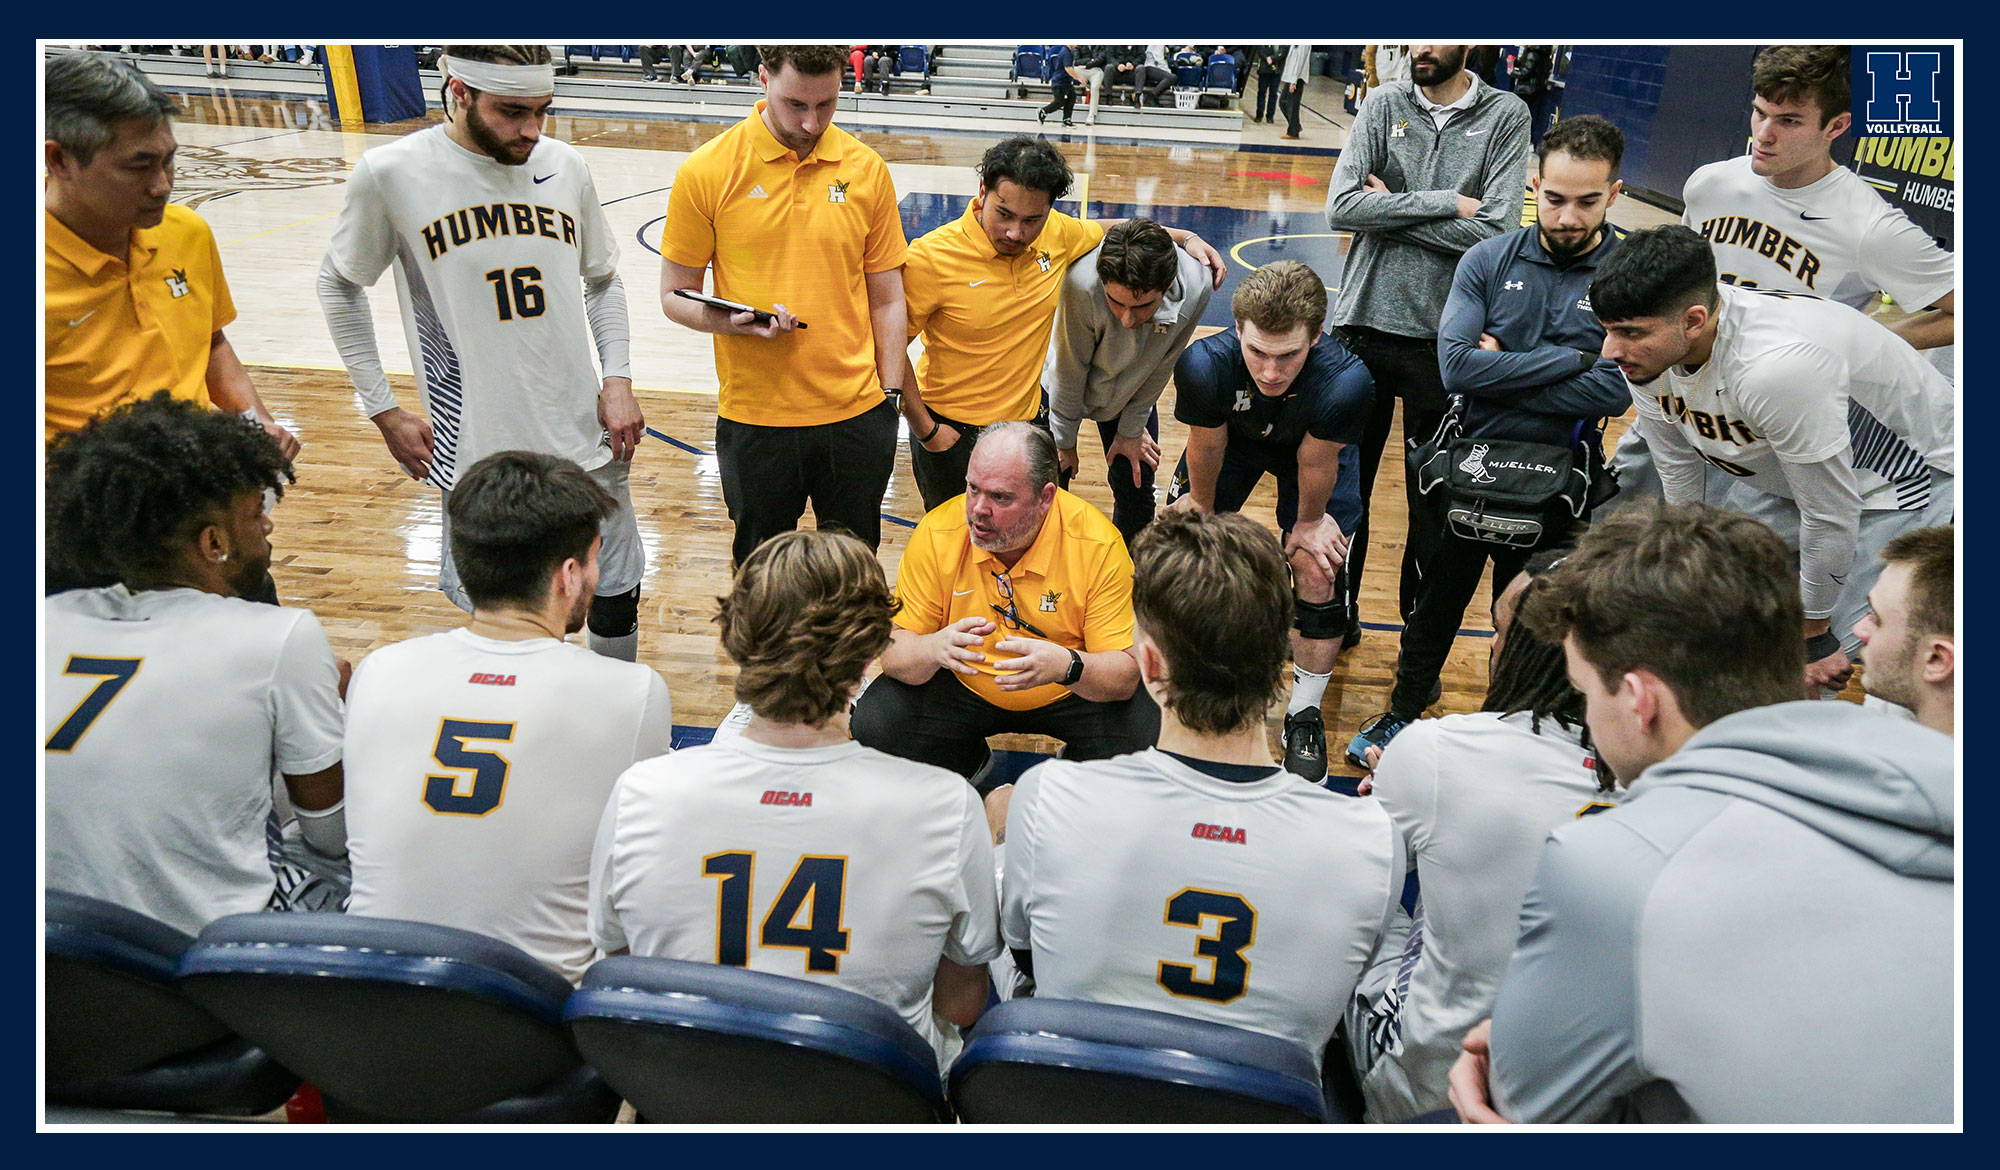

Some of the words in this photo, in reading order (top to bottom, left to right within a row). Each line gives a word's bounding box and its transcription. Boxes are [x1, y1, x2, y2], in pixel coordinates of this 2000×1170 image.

[828, 184, 846, 203] H
[421, 202, 577, 262] HUMBER
[1700, 215, 1821, 290] HUMBER
[163, 276, 191, 299] H
[485, 265, 546, 322] 16
[1654, 393, 1767, 447] BER
[1039, 593, 1057, 612] H
[45, 653, 146, 754] 7
[468, 672, 517, 687] OCAA
[420, 716, 518, 819] 5
[760, 790, 813, 807] OCAA
[1191, 822, 1247, 845] OCAA
[701, 849, 852, 975] 14
[1156, 885, 1259, 1006] 3
